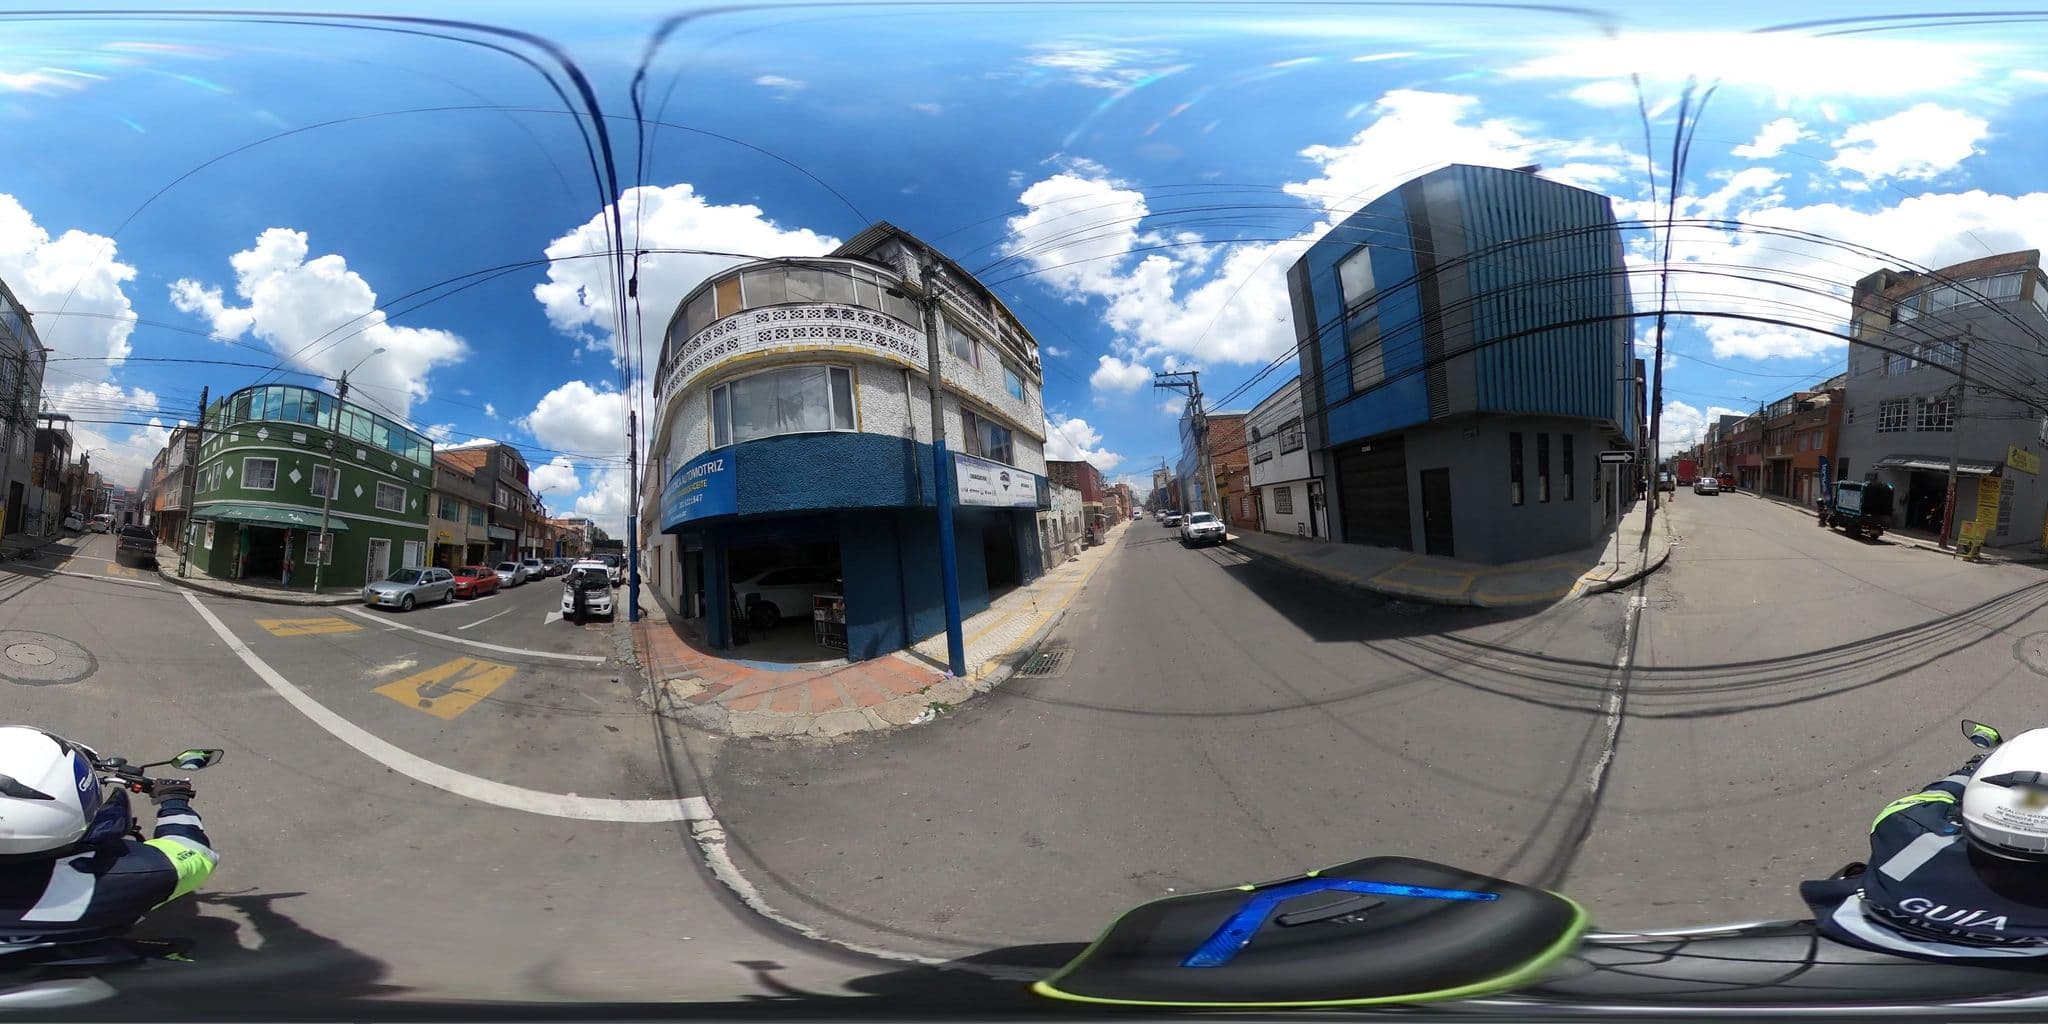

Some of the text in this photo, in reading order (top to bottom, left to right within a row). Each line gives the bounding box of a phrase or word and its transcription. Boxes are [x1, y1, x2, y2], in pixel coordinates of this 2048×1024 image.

[681, 458, 724, 485] AUTOMOTRIZ
[180, 525, 191, 573] JUGOS
[1898, 897, 2009, 931] GUÍA
